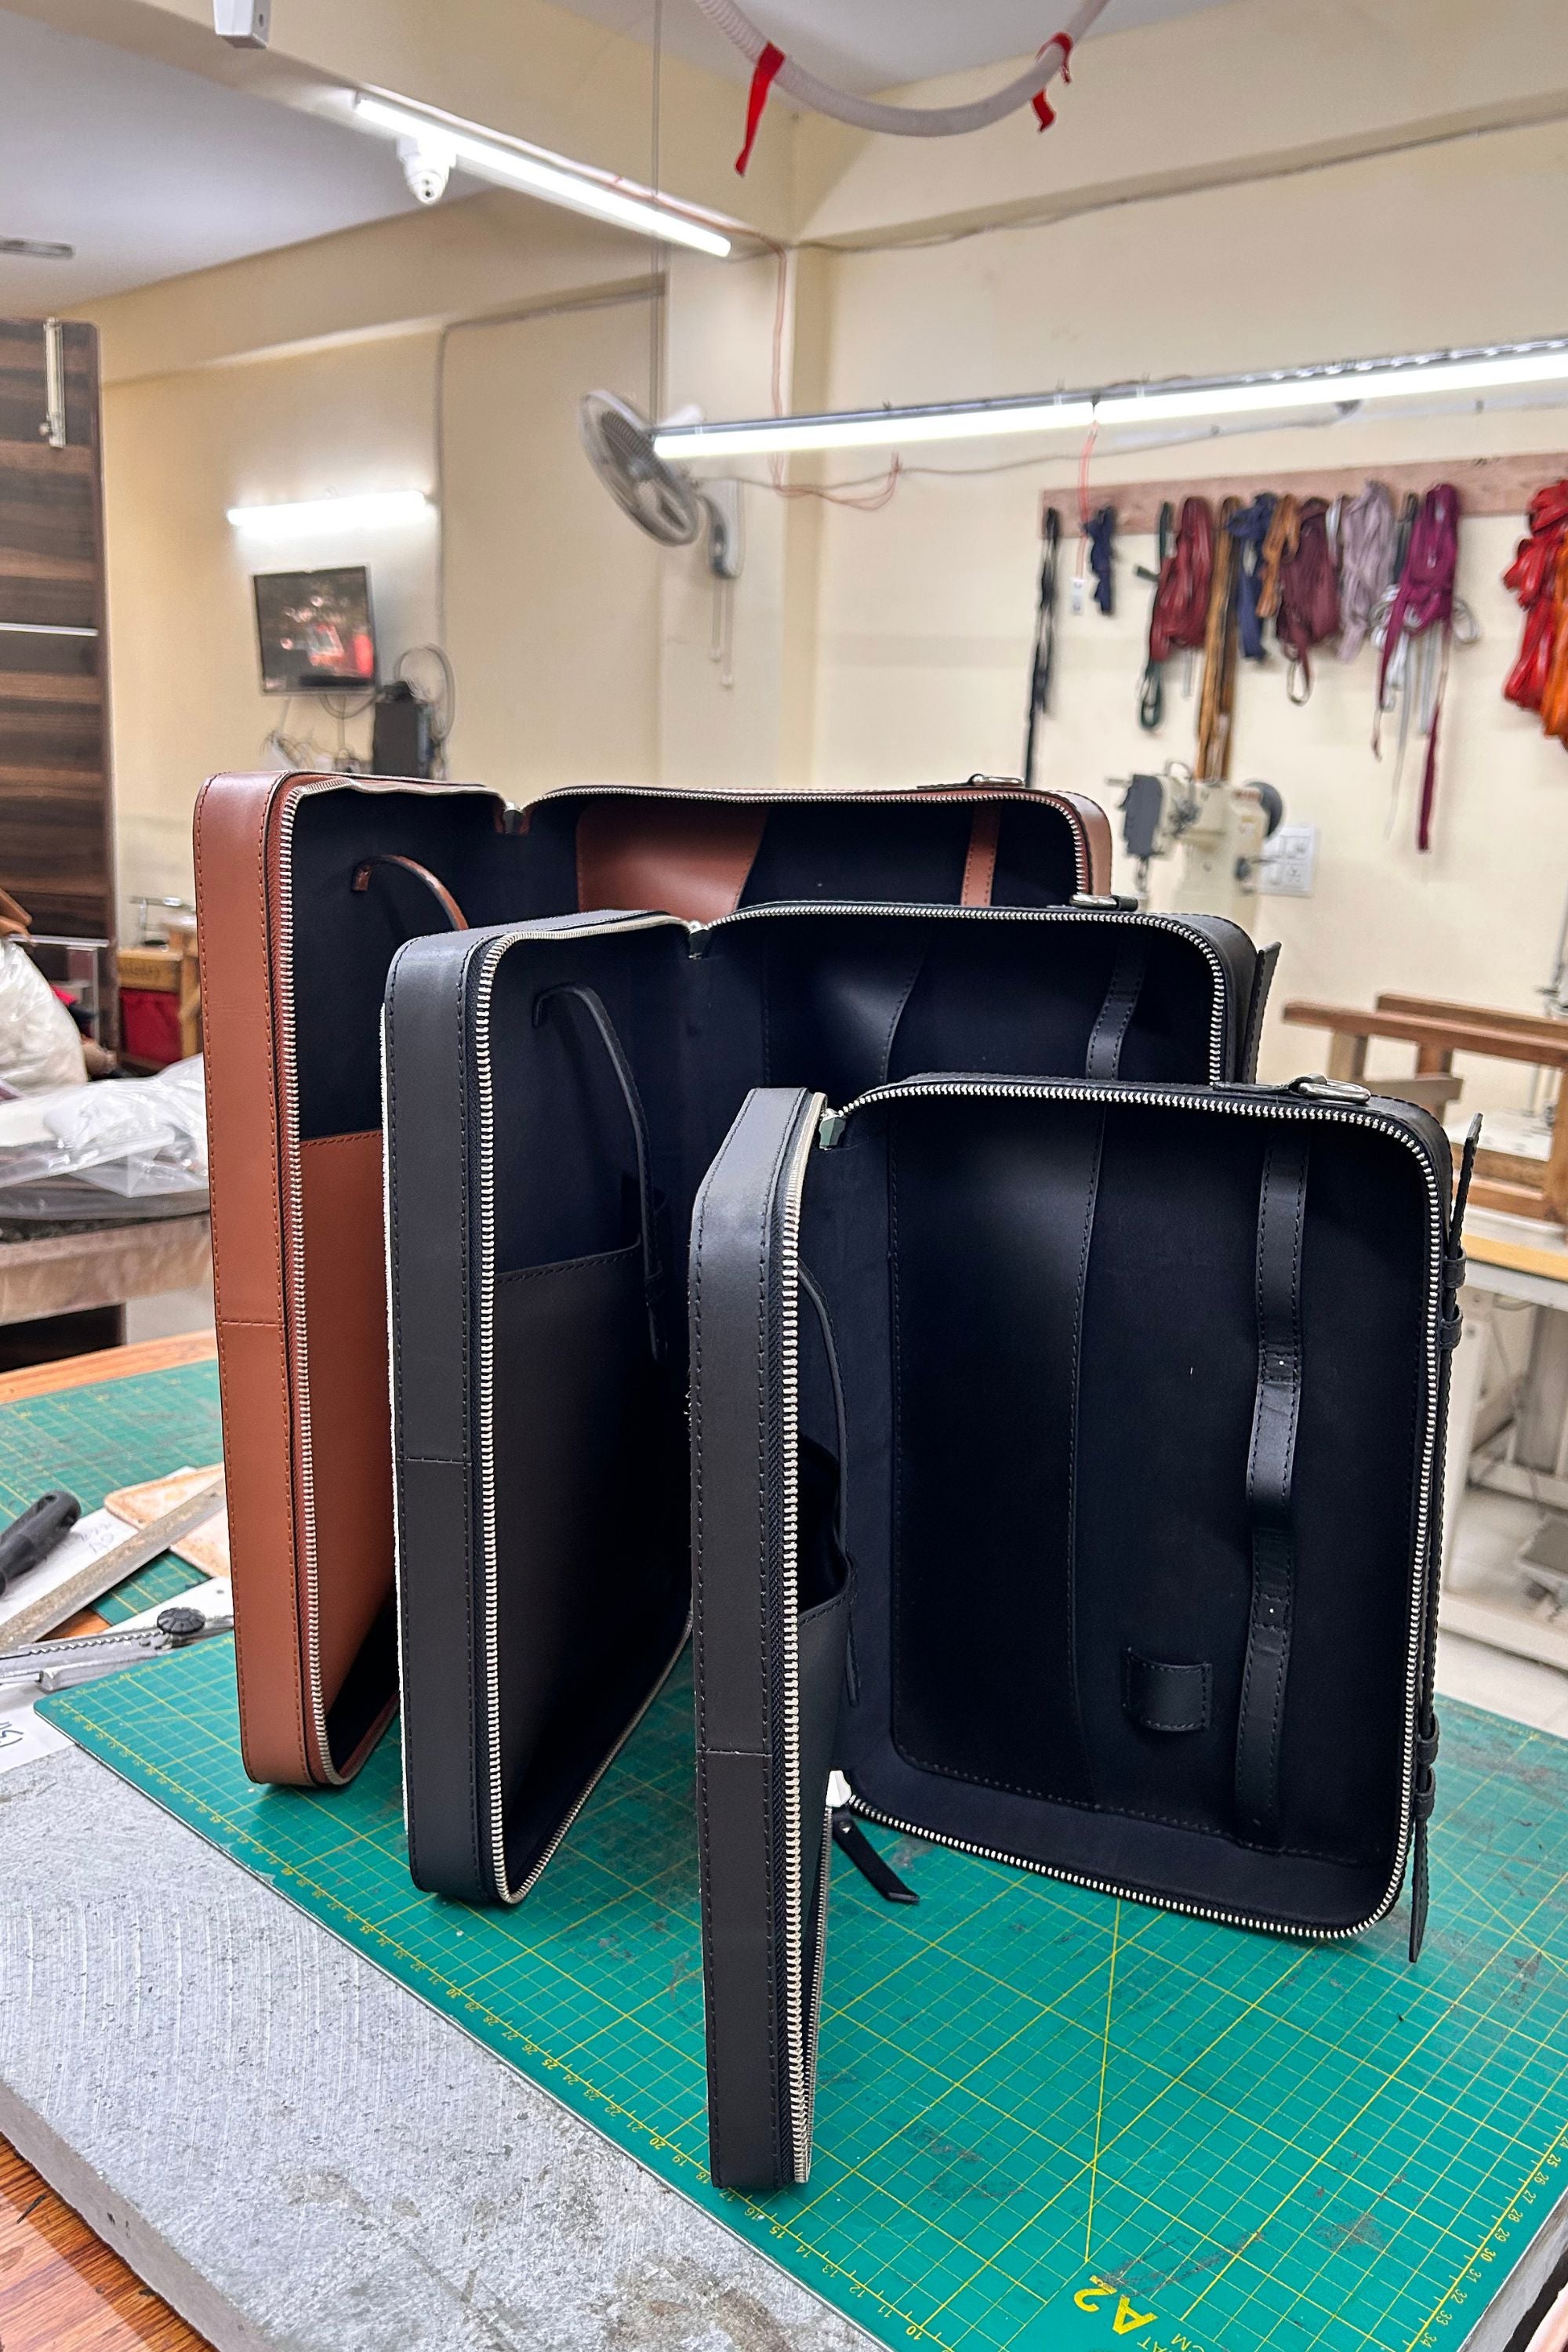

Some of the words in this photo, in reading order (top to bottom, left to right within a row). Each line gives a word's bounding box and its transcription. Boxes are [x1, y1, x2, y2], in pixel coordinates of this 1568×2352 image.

[359, 1925, 373, 1935] 35
[410, 1962, 425, 1972] 32
[428, 1976, 441, 1985] 31
[446, 1988, 461, 1998] 30
[464, 2002, 479, 2013] 29
[483, 2015, 499, 2026] 28
[502, 2031, 517, 2040] 27
[522, 2044, 538, 2055] 26
[542, 2059, 558, 2070] 25
[562, 2074, 579, 2085] 24
[583, 2089, 600, 2100] 23
[604, 2104, 621, 2117] 22
[626, 2121, 643, 2132] 21
[650, 2137, 666, 2149] 20
[672, 2154, 687, 2166] 19
[1547, 2154, 1561, 2168] 25
[696, 2171, 711, 2183] 18
[1534, 2172, 1549, 2185] 26
[719, 2191, 735, 2201] 17
[1523, 2190, 1537, 2204] 27
[744, 2207, 760, 2220] 16
[1508, 2209, 1523, 2222] 28
[769, 2226, 785, 2238] 15
[1494, 2227, 1510, 2241] 29
[796, 2245, 811, 2258] 14
[1480, 2248, 1496, 2262] 30
[822, 2264, 838, 2278] 13
[1465, 2268, 1482, 2283] 31
[849, 2284, 865, 2297] 12
[1451, 2289, 1467, 2303] 32
[877, 2305, 892, 2318] 11
[1074, 2275, 1159, 2335] A2
[1436, 2310, 1453, 2325] 33
[906, 2325, 923, 2339] 10
[1136, 2336, 1172, 2352] AT
[1421, 2332, 1437, 2348] 34
